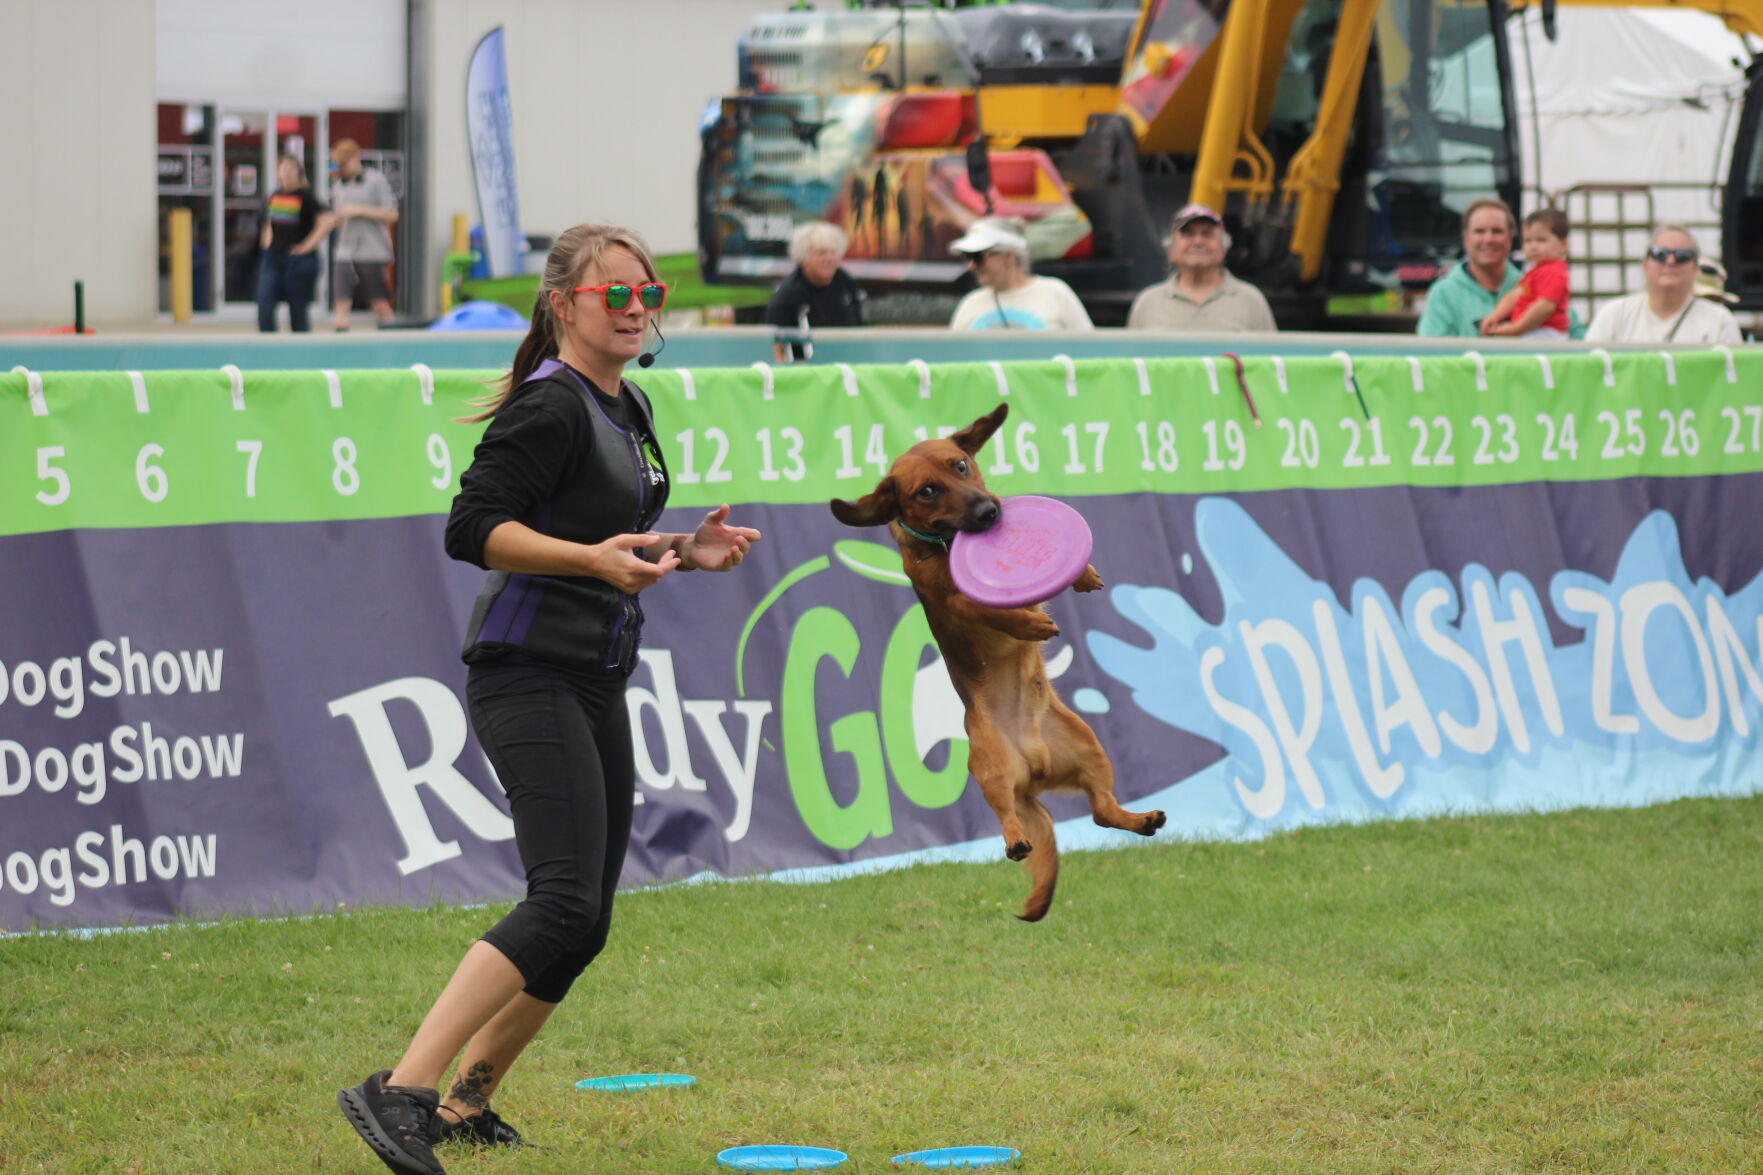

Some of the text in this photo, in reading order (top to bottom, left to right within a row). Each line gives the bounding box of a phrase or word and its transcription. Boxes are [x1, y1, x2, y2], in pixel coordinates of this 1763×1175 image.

[36, 445, 71, 506] 5
[135, 443, 168, 503] 6
[236, 440, 263, 498] 7
[332, 437, 361, 496] 8
[427, 433, 453, 491] 9
[675, 427, 733, 484] 12
[755, 426, 807, 482] 13
[834, 424, 888, 479] 14
[989, 420, 1040, 476] 16
[1061, 421, 1110, 474] 17
[1136, 420, 1179, 473] 18
[1202, 420, 1246, 471] 19
[1277, 417, 1320, 469] 20
[1339, 417, 1391, 468] 21
[1409, 415, 1454, 466] 22
[1472, 413, 1519, 464] 23
[1536, 412, 1579, 461] 24
[1597, 409, 1646, 459] 25
[1659, 408, 1700, 457] 26
[1721, 405, 1762, 454] 27
[1200, 580, 1564, 818] SPLASH
[0, 824, 217, 907] ogShow
